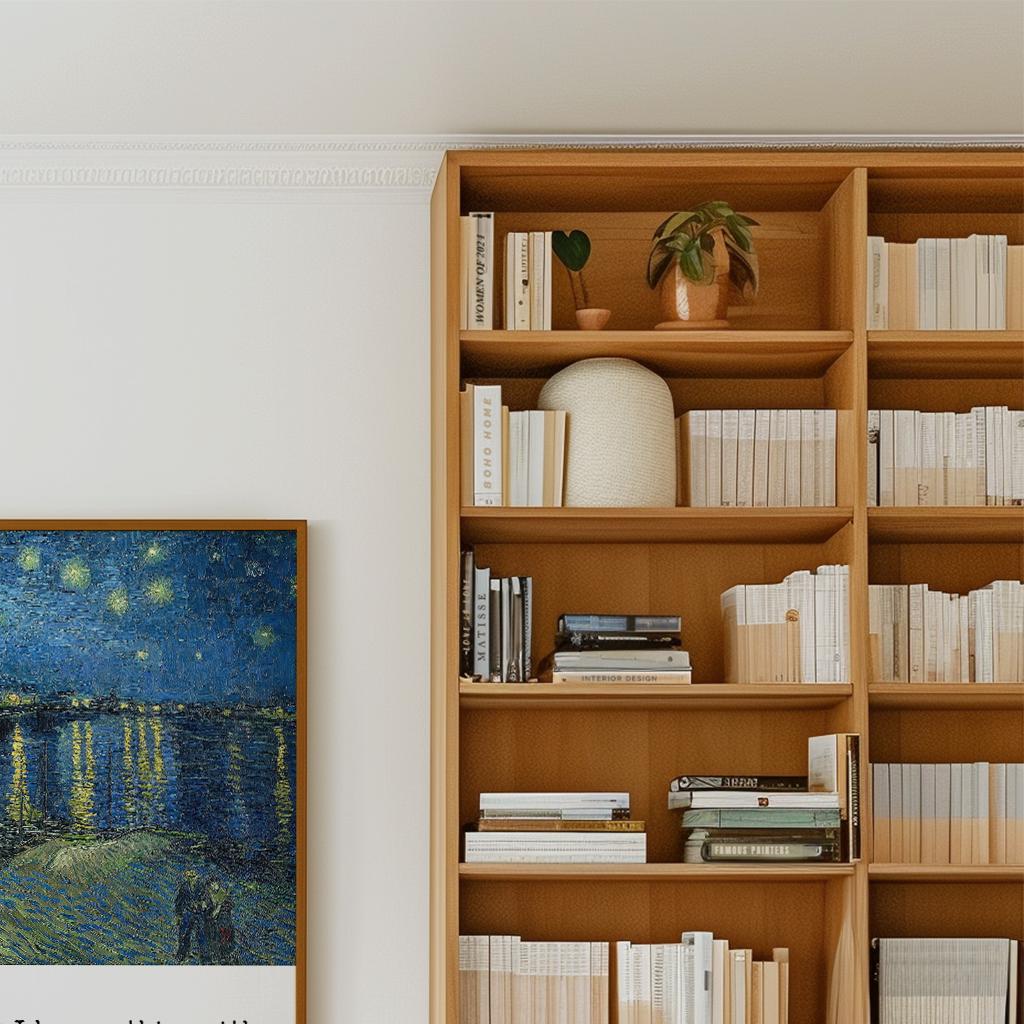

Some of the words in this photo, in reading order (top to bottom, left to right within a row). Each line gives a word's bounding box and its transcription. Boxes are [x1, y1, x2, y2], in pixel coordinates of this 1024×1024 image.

[476, 234, 485, 259] 2024
[476, 260, 485, 275] OF
[476, 279, 485, 323] WOMEN
[483, 398, 492, 440] HOME
[483, 447, 492, 489] BOHO
[477, 593, 487, 661] MATISSE
[713, 845, 747, 855] FAMOUS
[750, 845, 790, 855] PAINTERS
